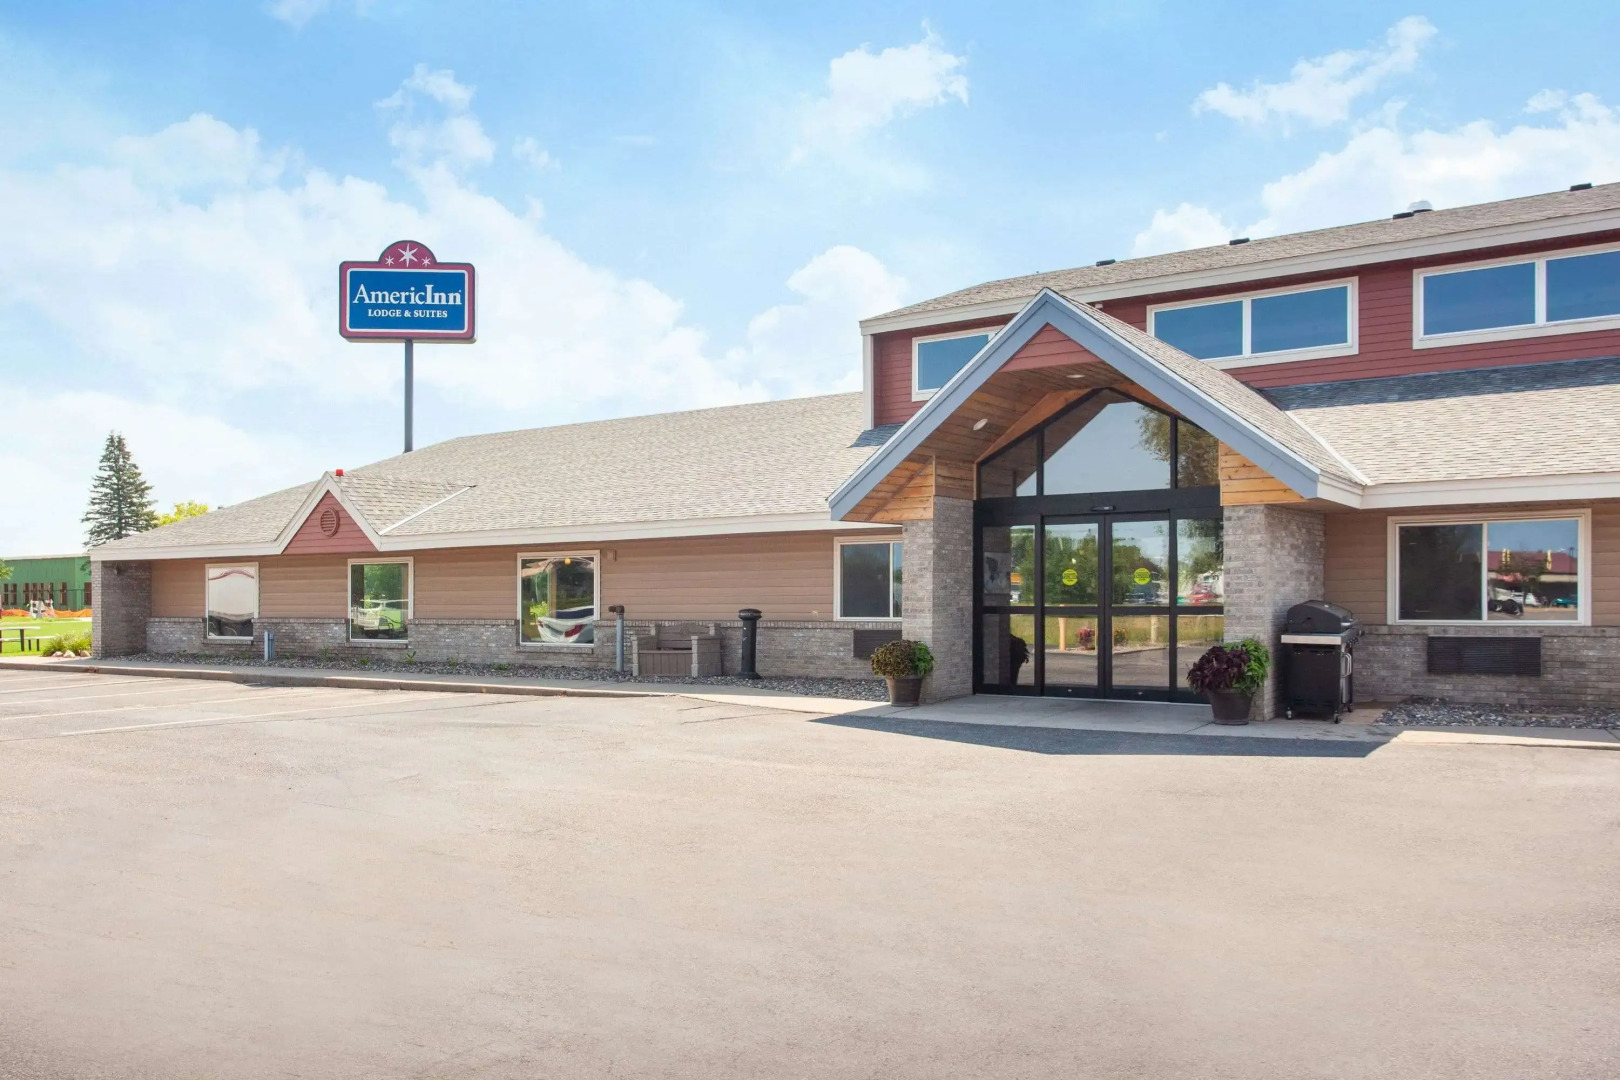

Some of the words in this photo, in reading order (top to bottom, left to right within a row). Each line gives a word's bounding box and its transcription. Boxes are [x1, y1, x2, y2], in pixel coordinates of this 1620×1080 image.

[352, 283, 462, 305] AmericInn
[368, 309, 402, 317] LODGE
[404, 309, 412, 317] &
[413, 310, 448, 318] SUITES
